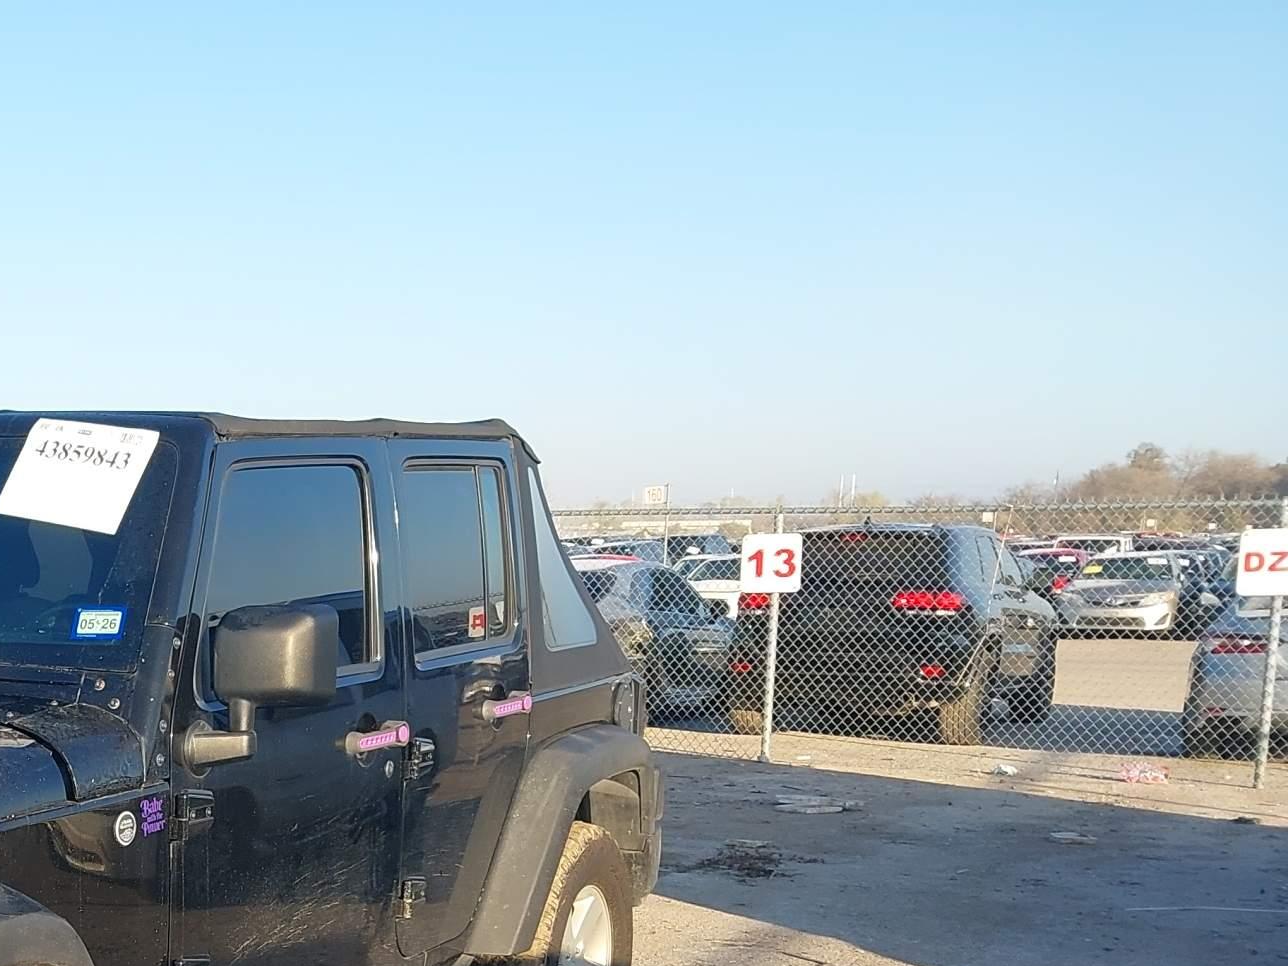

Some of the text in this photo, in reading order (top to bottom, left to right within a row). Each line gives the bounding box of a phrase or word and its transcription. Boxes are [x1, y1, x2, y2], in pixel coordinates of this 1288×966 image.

[35, 440, 131, 470] 43859843
[748, 548, 796, 578] 13
[139, 797, 164, 818] Babe
[141, 820, 167, 838] Power
